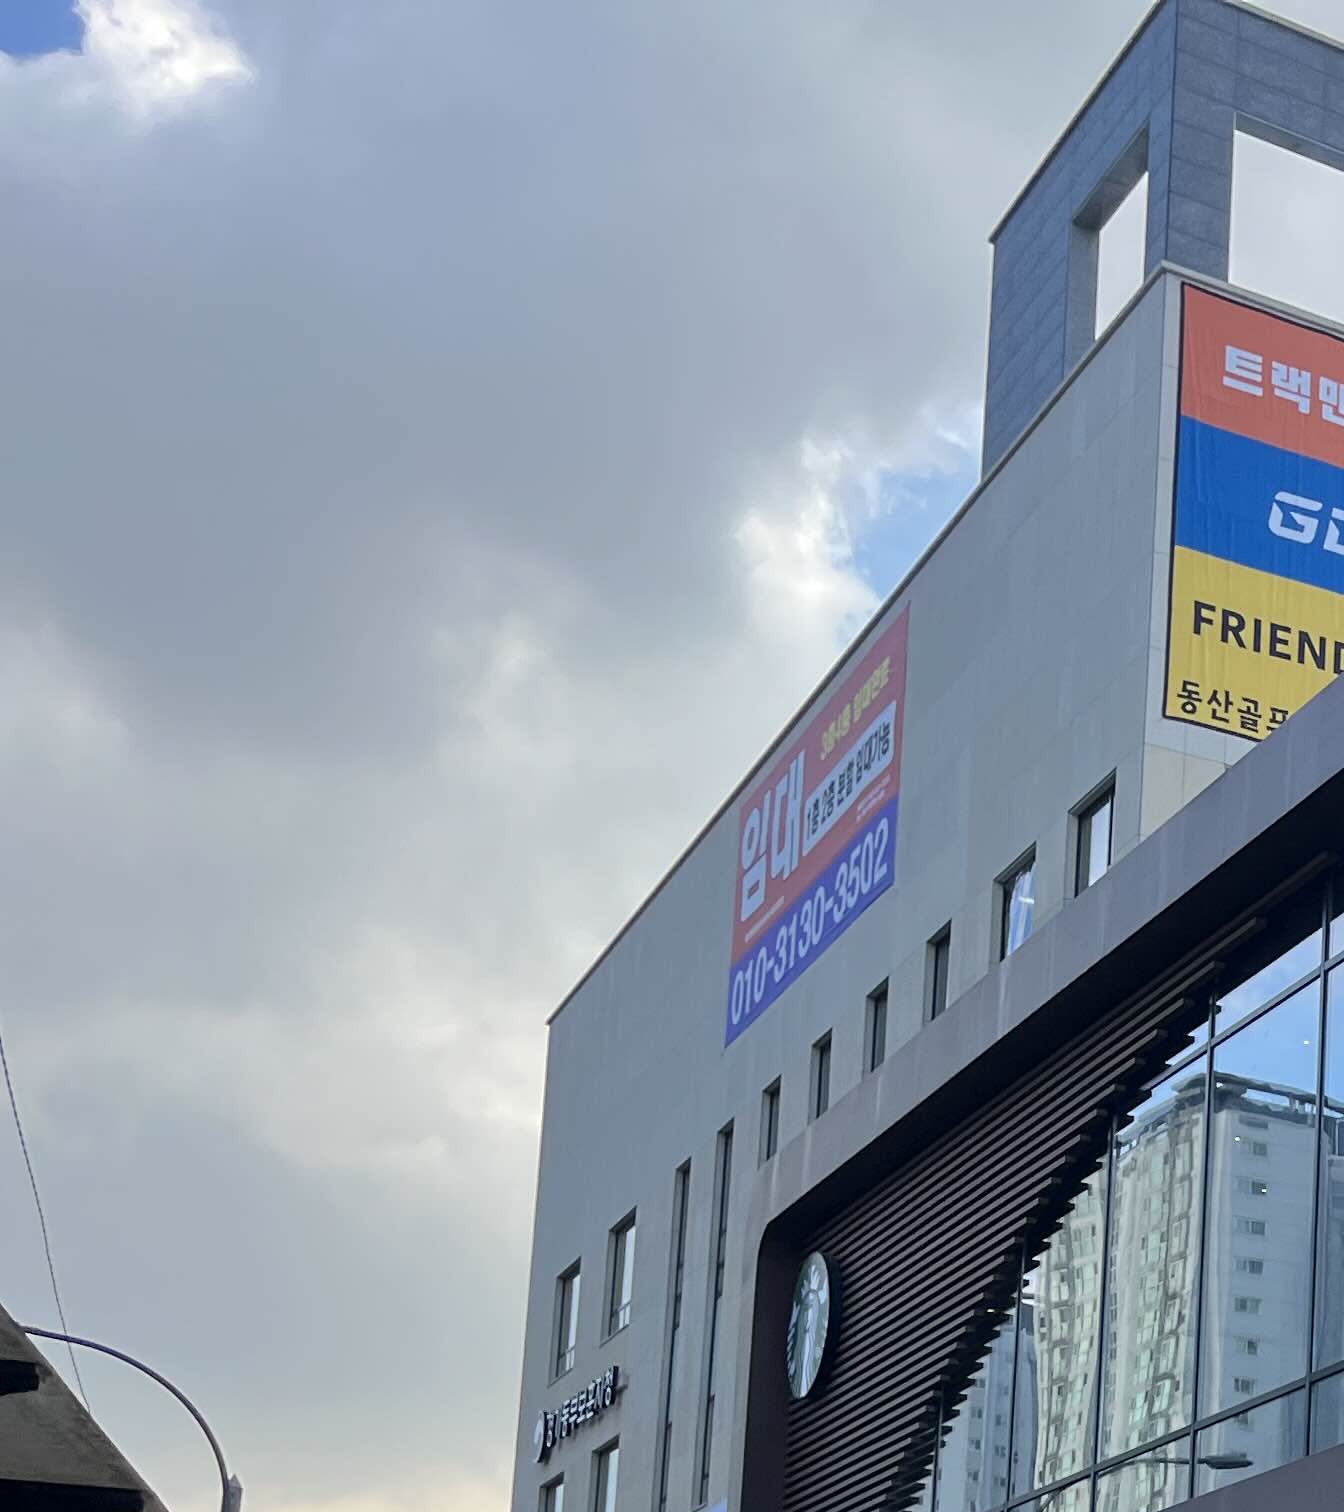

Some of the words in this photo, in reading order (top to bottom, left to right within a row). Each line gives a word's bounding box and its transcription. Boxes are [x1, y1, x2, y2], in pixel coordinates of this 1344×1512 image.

[1176, 681, 1289, 735] 동산골프
[731, 817, 889, 1025] 010-3130-3502
[741, 750, 805, 921] 임대
